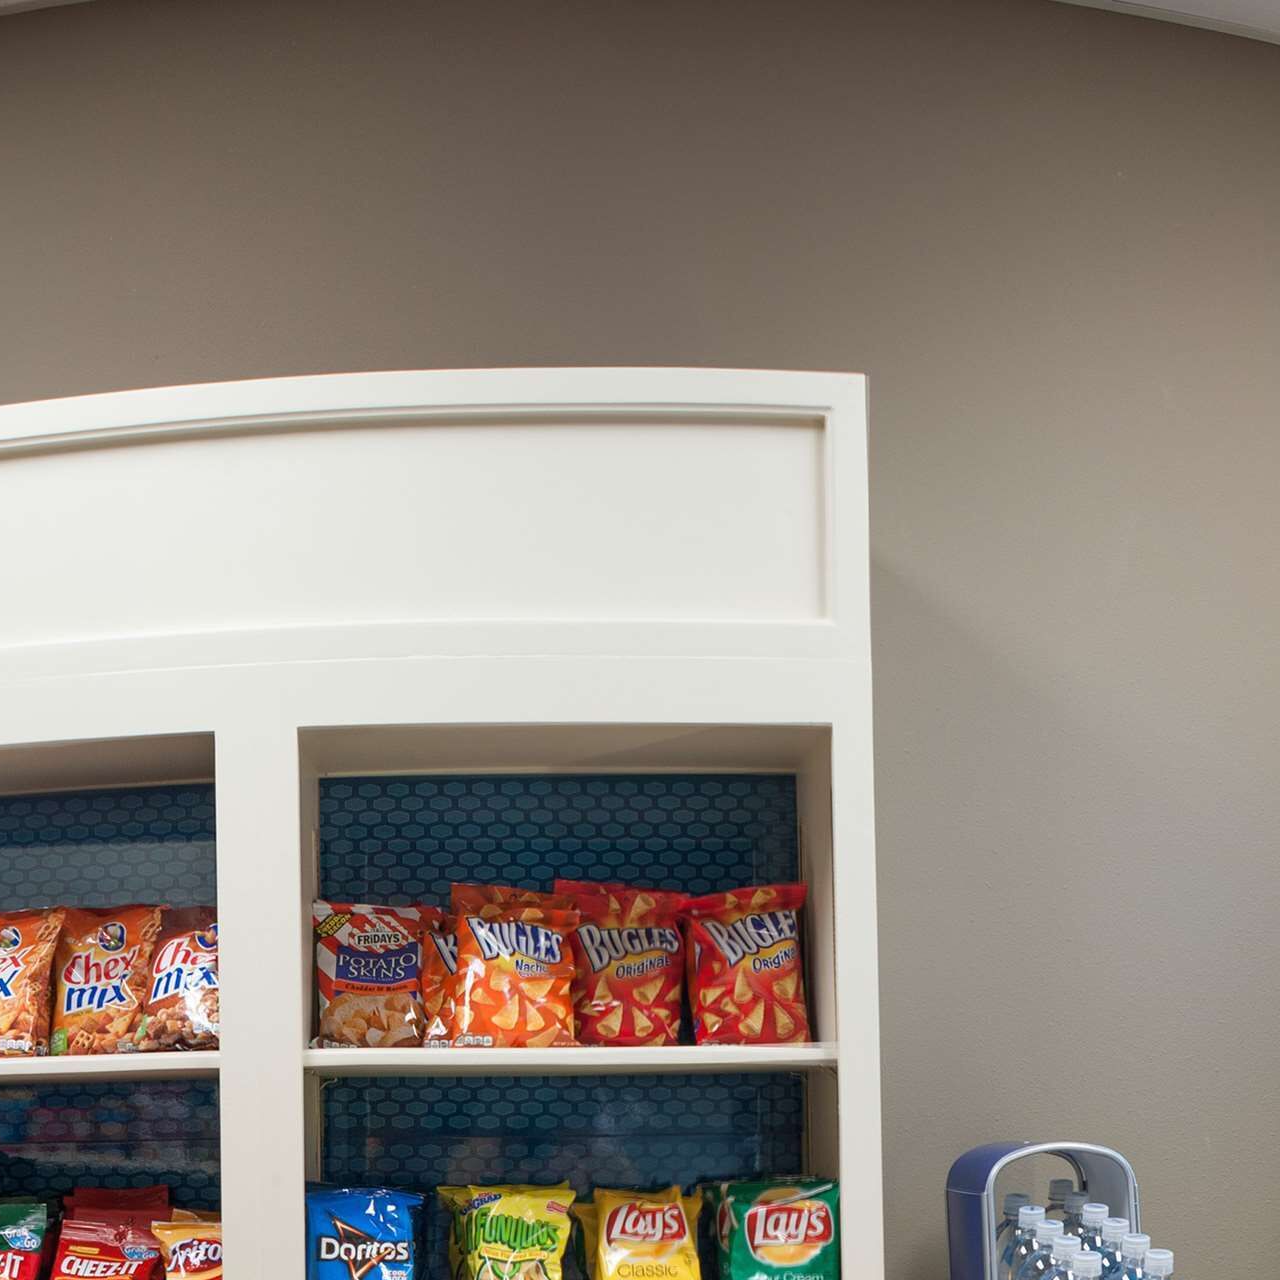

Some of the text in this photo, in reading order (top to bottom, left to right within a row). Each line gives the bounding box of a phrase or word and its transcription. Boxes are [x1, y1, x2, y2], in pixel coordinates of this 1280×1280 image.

[468, 916, 563, 964] BUGLES
[577, 923, 680, 973] BUGLES
[64, 945, 139, 985] Chex
[338, 953, 417, 968] POTATO
[348, 965, 405, 979] SKINS
[64, 971, 129, 1013] mix
[610, 1202, 680, 1241] Lay's
[754, 1206, 827, 1246] Lay's
[60, 1255, 144, 1278] CHEEZ-IT
[320, 1236, 410, 1262] Doritos
[617, 1263, 679, 1278] Classic
